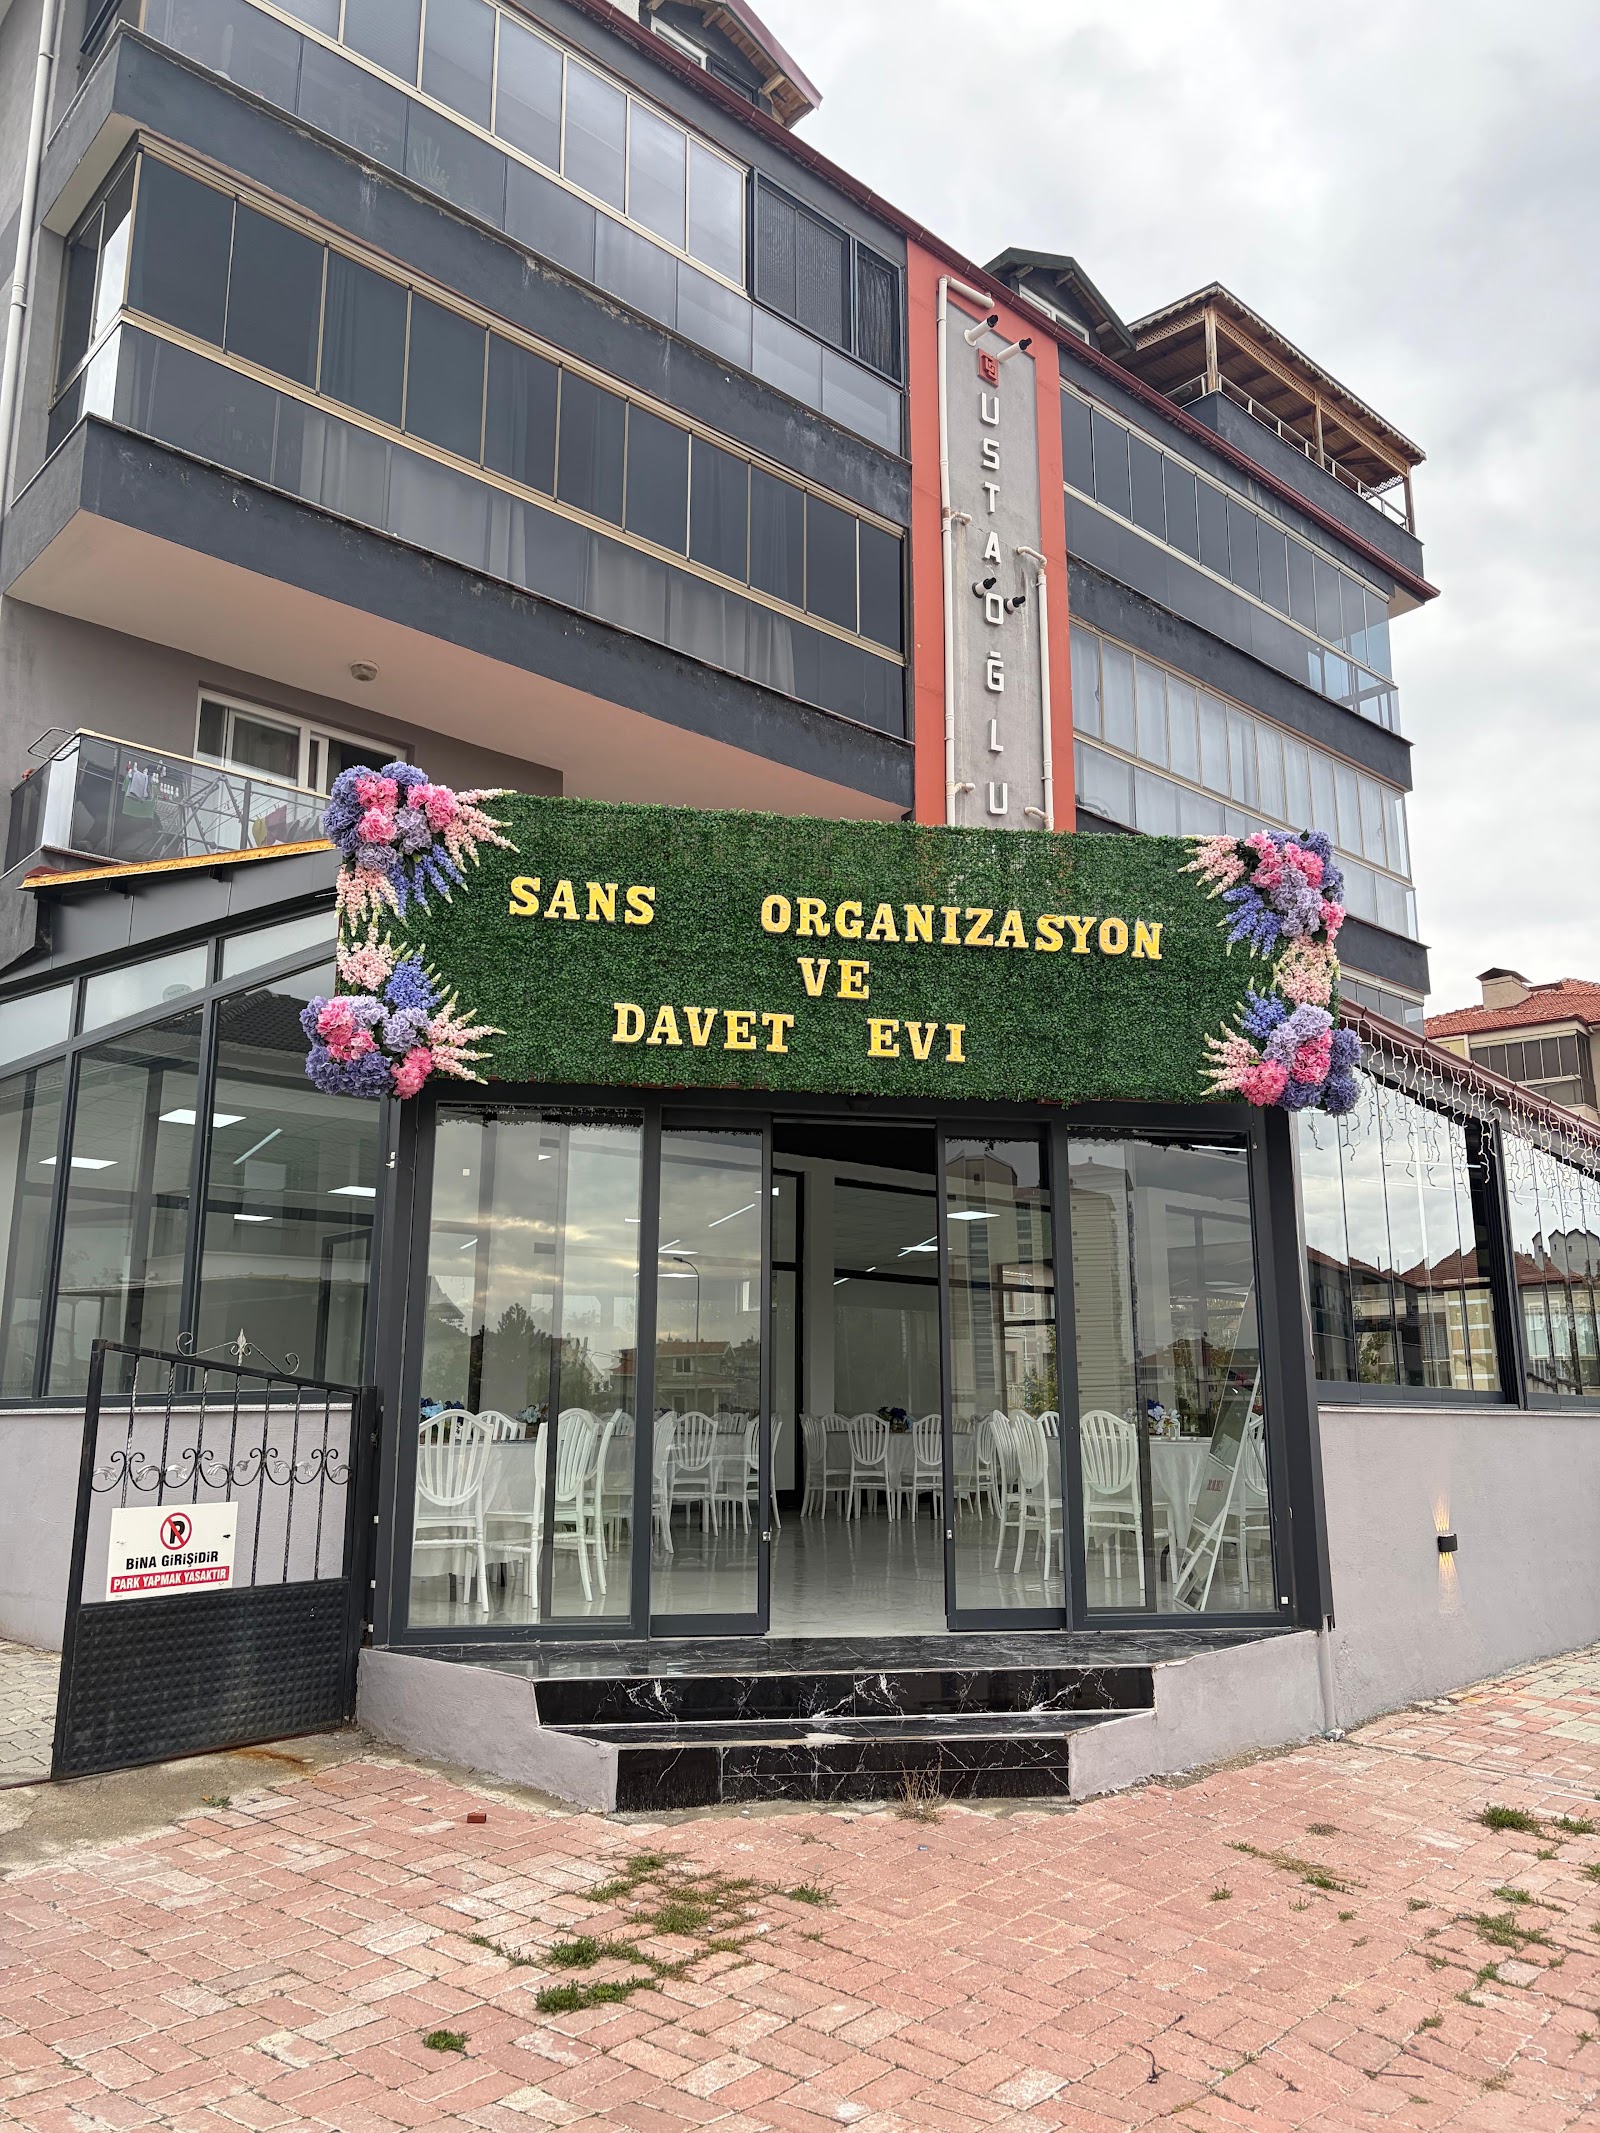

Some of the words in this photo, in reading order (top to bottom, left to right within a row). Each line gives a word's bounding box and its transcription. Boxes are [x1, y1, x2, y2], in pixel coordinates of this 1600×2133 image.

[980, 391, 1008, 815] USTAOĞLU
[509, 876, 656, 925] SANS
[760, 894, 1163, 960] ORGANIZASYON
[797, 957, 870, 1000] VE
[612, 1002, 794, 1053] DAVET
[867, 1018, 966, 1063] EVI
[113, 1577, 141, 1591] PARK
[142, 1572, 181, 1588] YAPMAK
[184, 1568, 227, 1583] YASAKTIR
